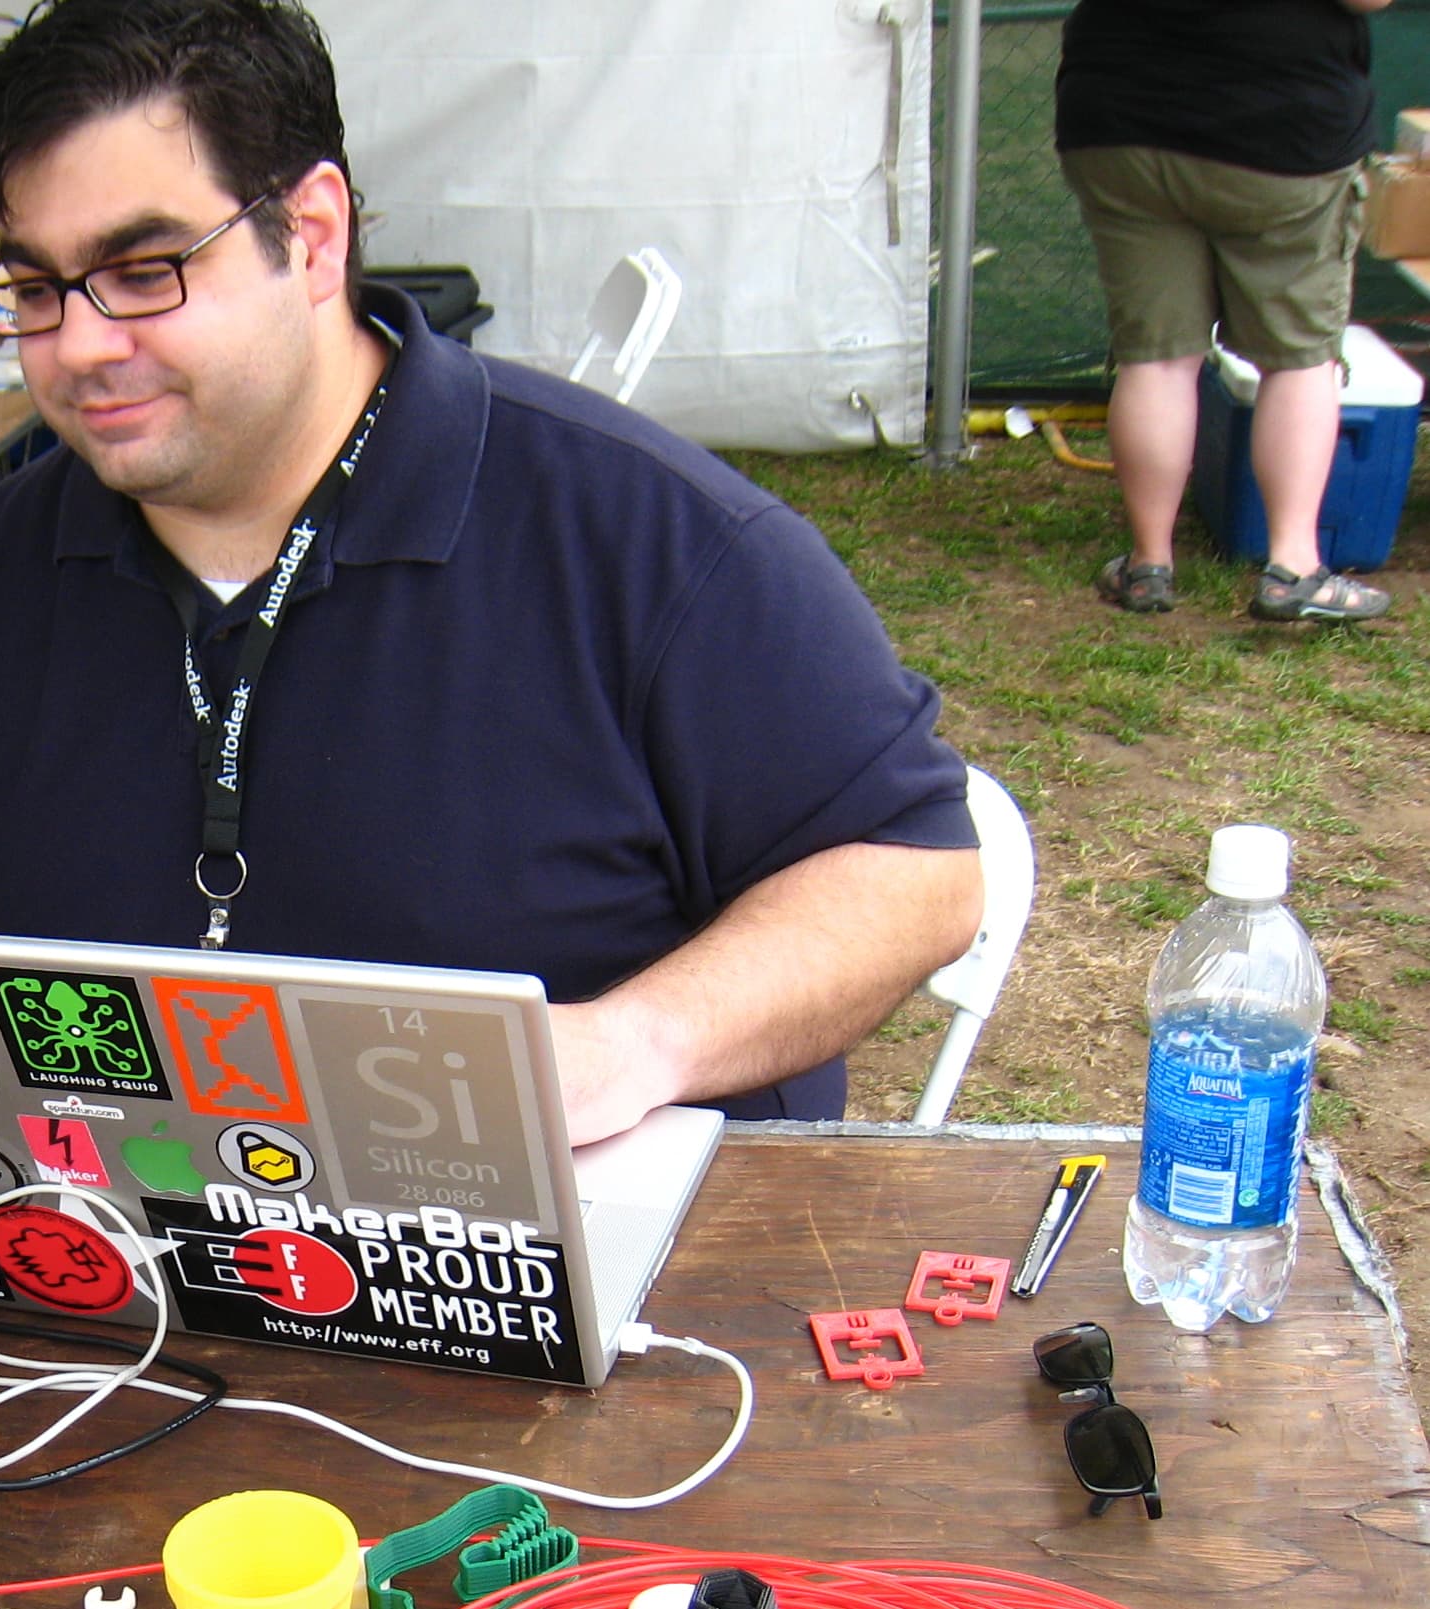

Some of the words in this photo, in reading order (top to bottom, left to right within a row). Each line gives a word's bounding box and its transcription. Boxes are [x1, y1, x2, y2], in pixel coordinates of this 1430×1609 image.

[258, 518, 317, 628] Autodesk
[217, 680, 251, 793] Autodesk
[378, 1006, 429, 1037] 14
[29, 1071, 109, 1090] LAUGHING
[111, 1078, 160, 1093] SQUID
[355, 1044, 480, 1145] Si
[1186, 1072, 1244, 1100] AQUAFINA
[366, 1146, 500, 1185] Silicon
[203, 1182, 558, 1260] MakerBot
[396, 1182, 486, 1209] 28.086
[357, 1239, 554, 1299] PROUD
[263, 1315, 490, 1364] http://www.eff.org
[368, 1285, 563, 1345] MEMBER
